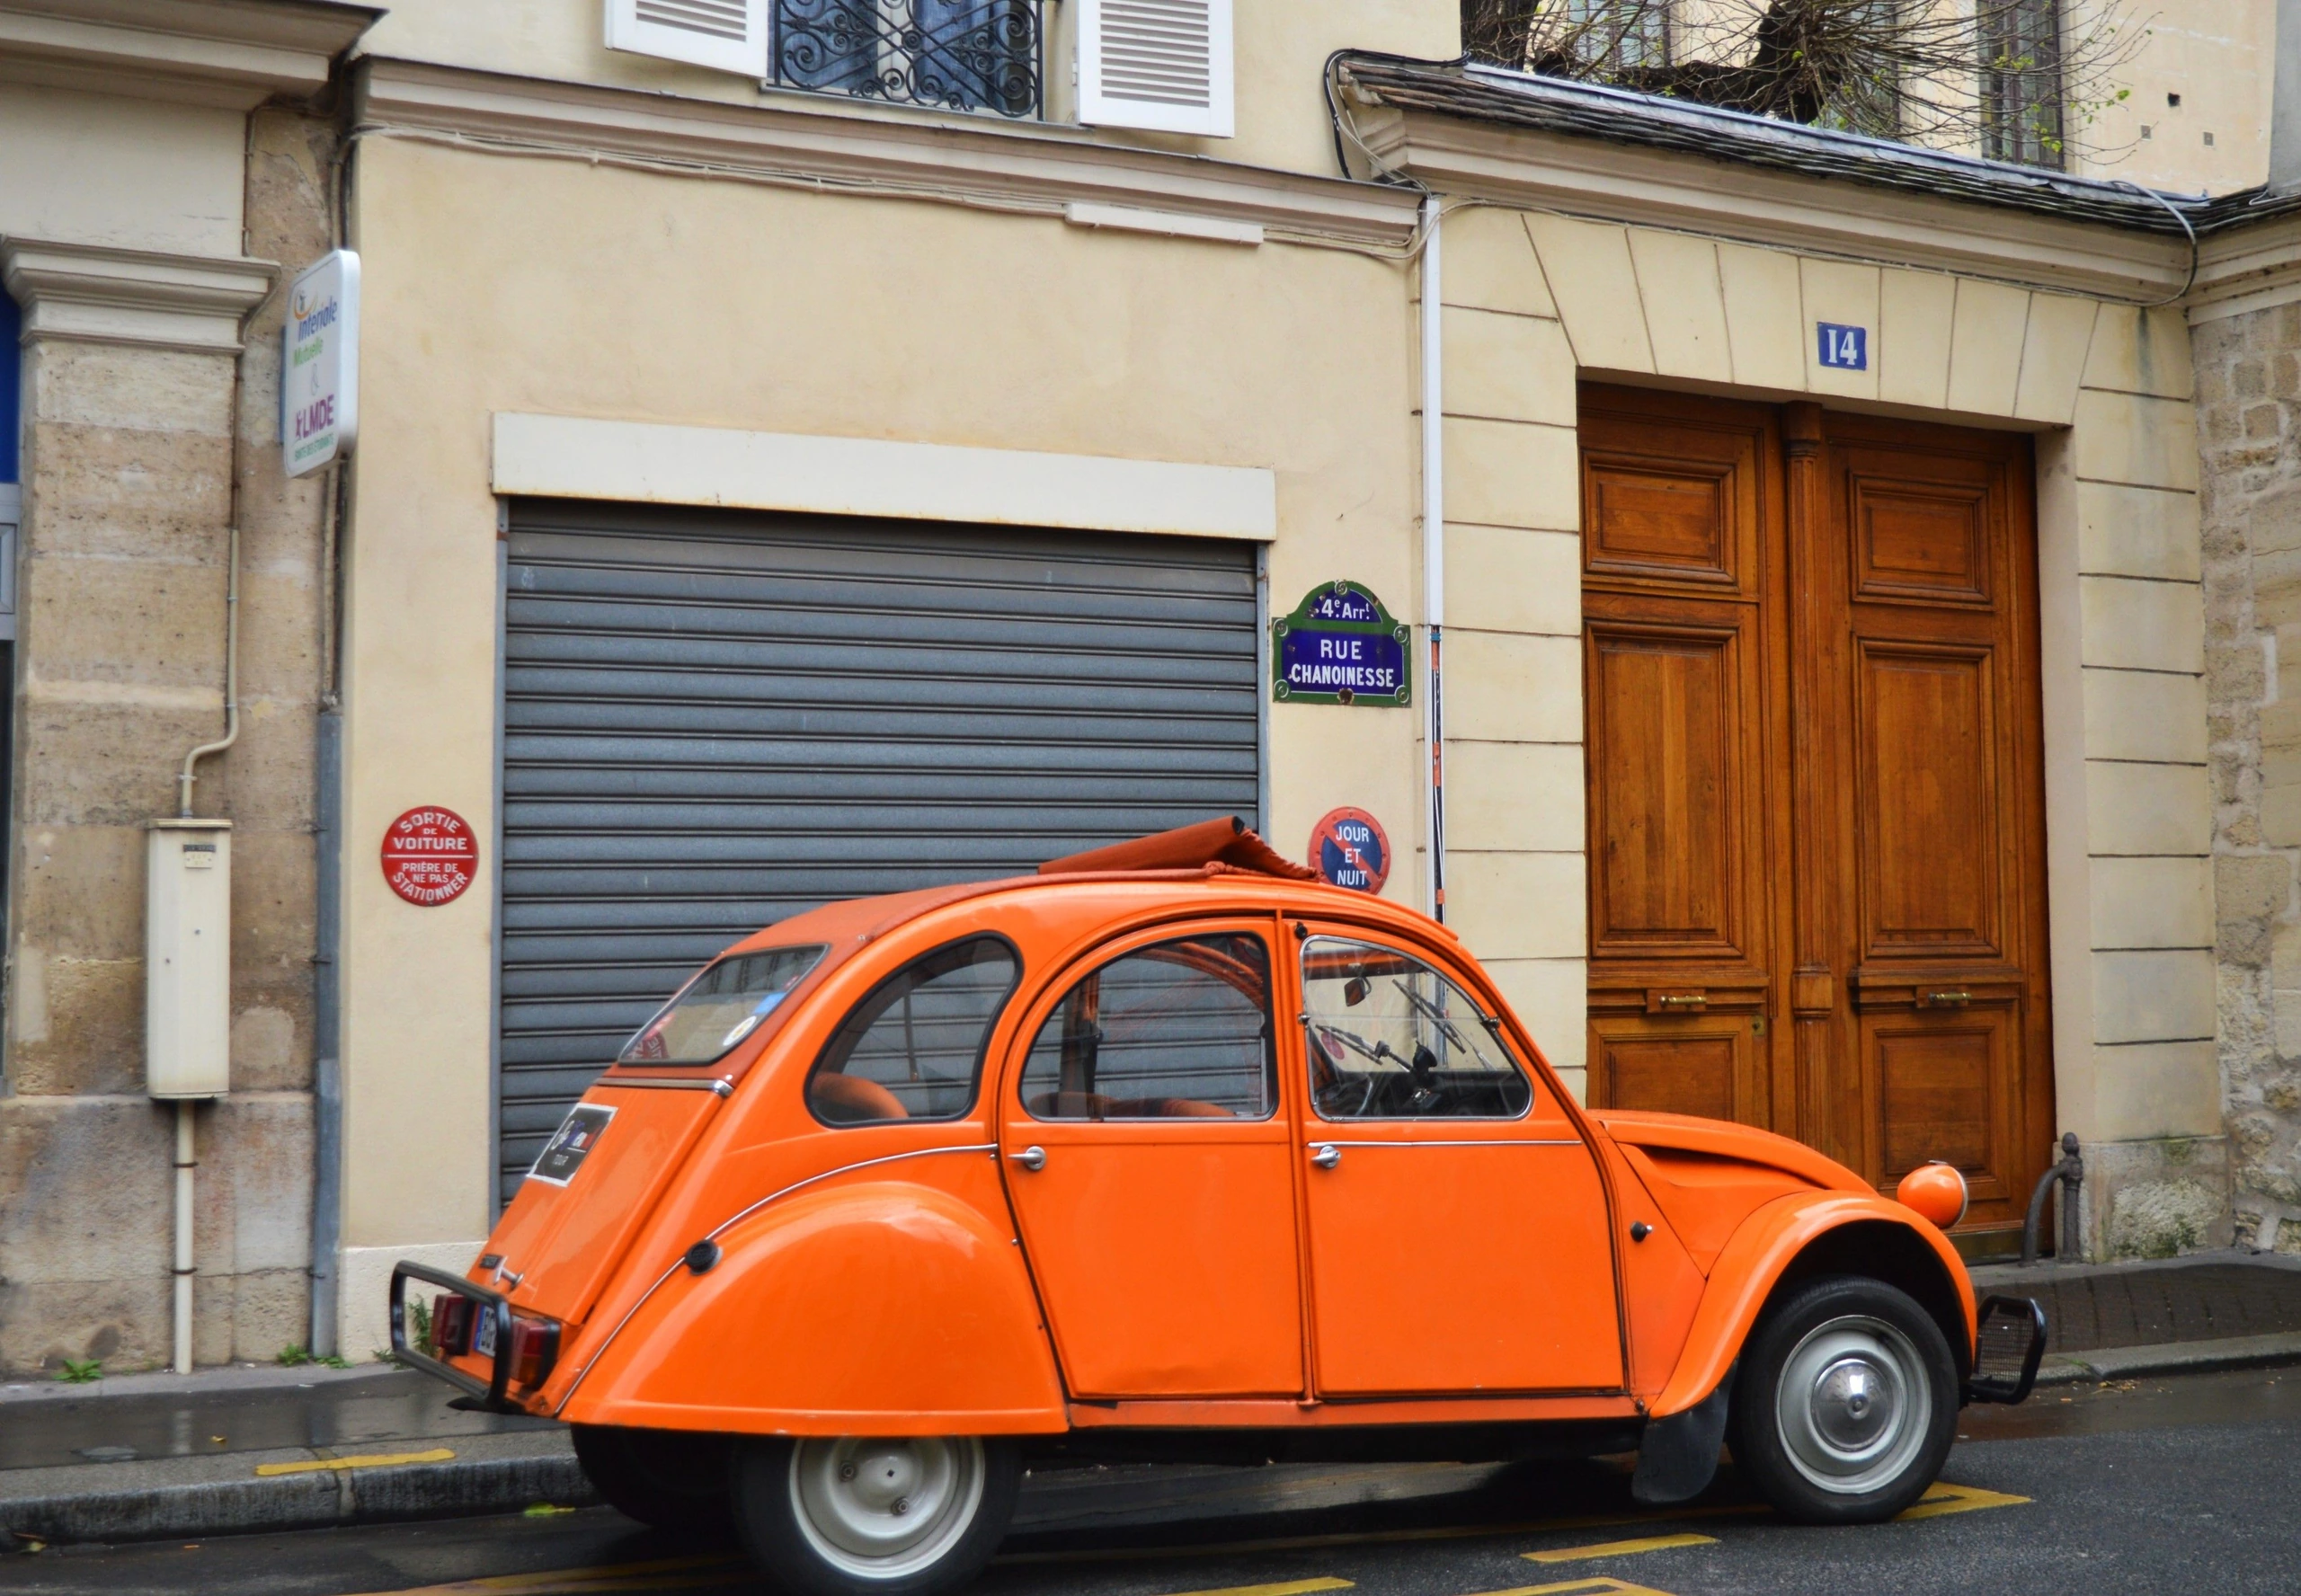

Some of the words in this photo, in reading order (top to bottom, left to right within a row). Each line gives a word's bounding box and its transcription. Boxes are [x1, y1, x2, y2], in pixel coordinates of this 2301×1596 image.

[1827, 329, 1858, 365] 14
[303, 394, 334, 439] LMDE
[1320, 639, 1362, 660] RUE
[1291, 663, 1394, 687] CHANOINESSE
[399, 811, 461, 834] SORTIE
[393, 837, 468, 850] VOITURE
[1336, 826, 1370, 842] JOUR
[1345, 847, 1362, 864] ET
[413, 873, 426, 882] NE
[430, 873, 449, 882] PAS
[444, 863, 458, 873] DE
[1337, 870, 1367, 885] NUIT
[393, 872, 468, 901] STATIONNER
